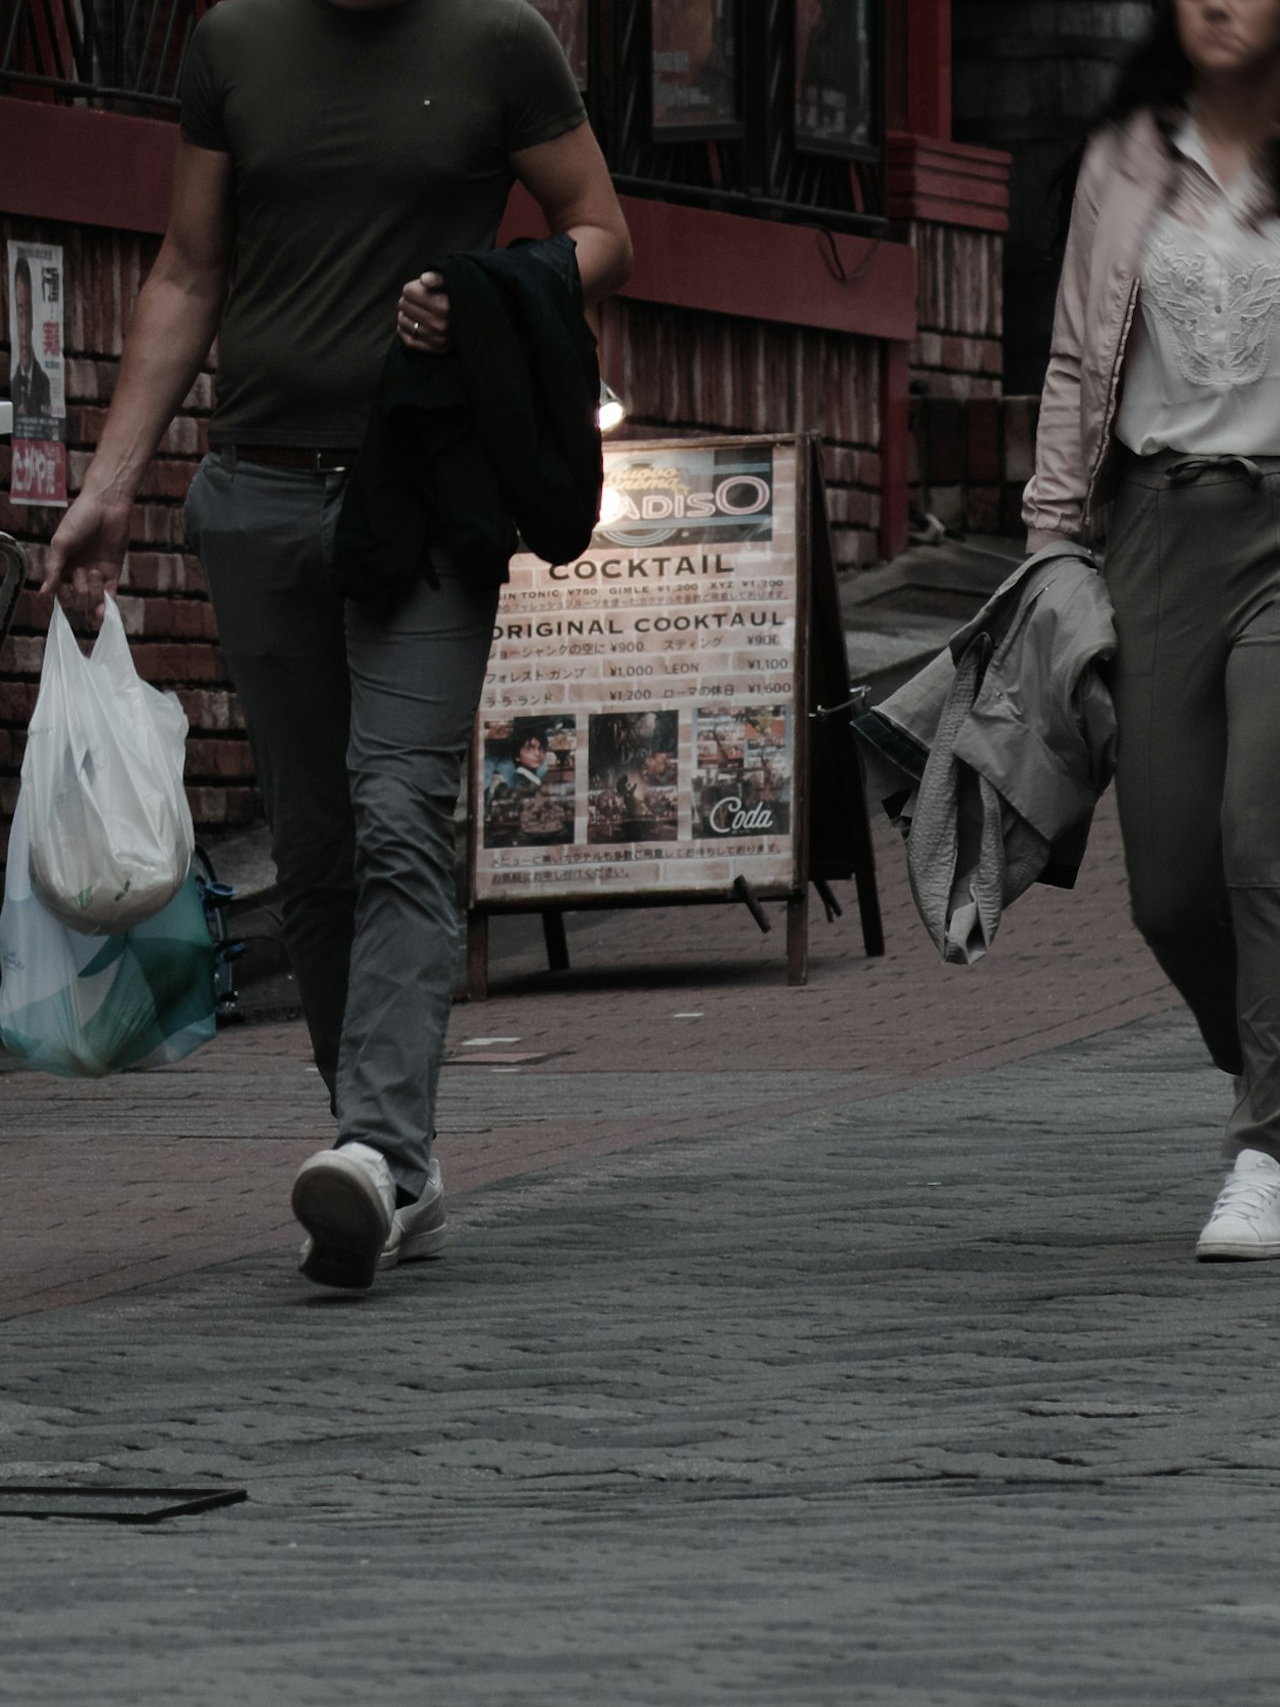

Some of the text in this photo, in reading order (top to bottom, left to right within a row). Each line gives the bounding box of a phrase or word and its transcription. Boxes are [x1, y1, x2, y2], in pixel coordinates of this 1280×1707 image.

[548, 553, 735, 583] COCKTAIL
[520, 590, 560, 600] TONIC
[567, 587, 599, 597] ¥750
[608, 586, 650, 595] GIMLE
[656, 582, 699, 594] ¥1,200
[709, 581, 733, 591] XYZ
[491, 610, 786, 642] ORIGINAL COOKTAUL
[609, 640, 646, 655] ¥900
[662, 634, 724, 653] スティング
[609, 663, 654, 679] ¥1,000
[663, 661, 701, 676] LEON
[746, 656, 790, 672] ¥1,100
[608, 687, 653, 703] ¥1,200
[662, 682, 736, 700] ローマの休日
[708, 795, 774, 834] Coda
